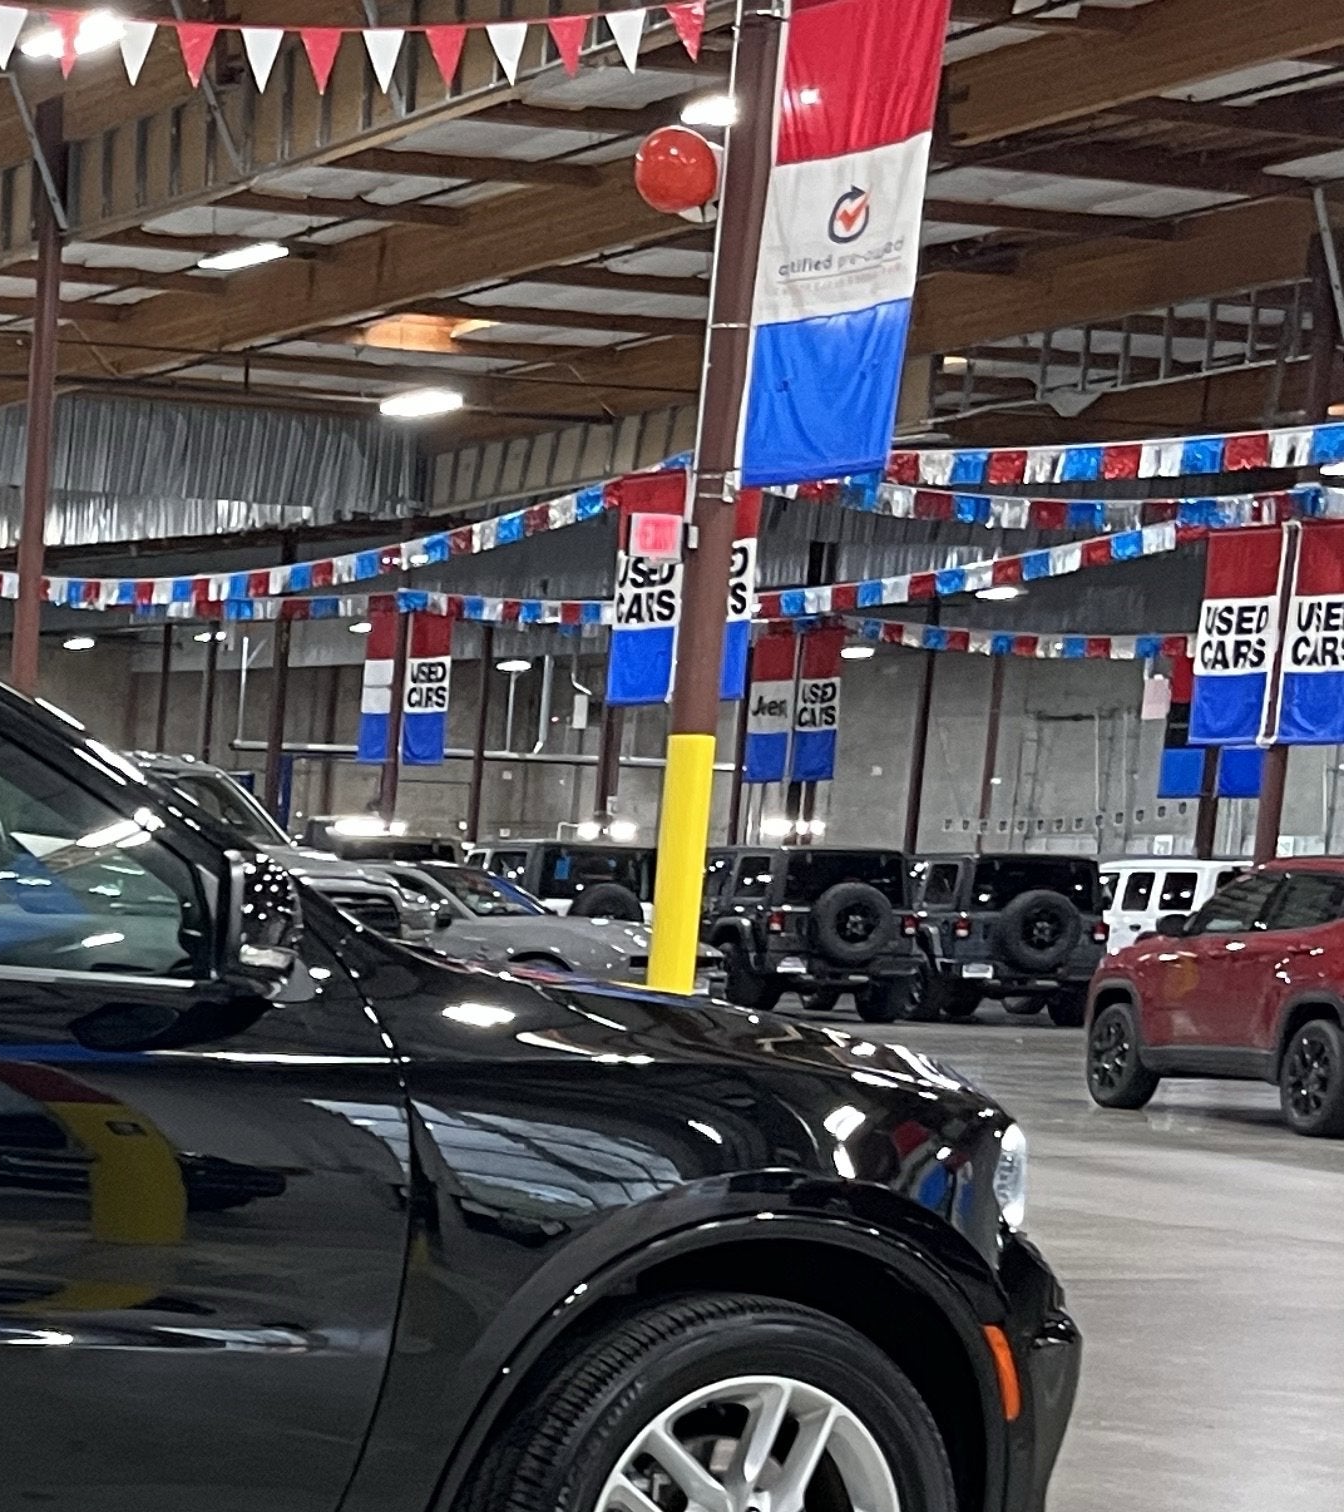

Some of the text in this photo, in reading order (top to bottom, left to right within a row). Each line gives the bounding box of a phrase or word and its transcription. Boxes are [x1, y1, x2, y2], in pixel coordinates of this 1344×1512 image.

[1205, 604, 1269, 636] USED
[1297, 602, 1344, 632] USE
[1201, 638, 1266, 669] CARS
[1291, 636, 1344, 666] CAR
[798, 705, 836, 727] CAS
